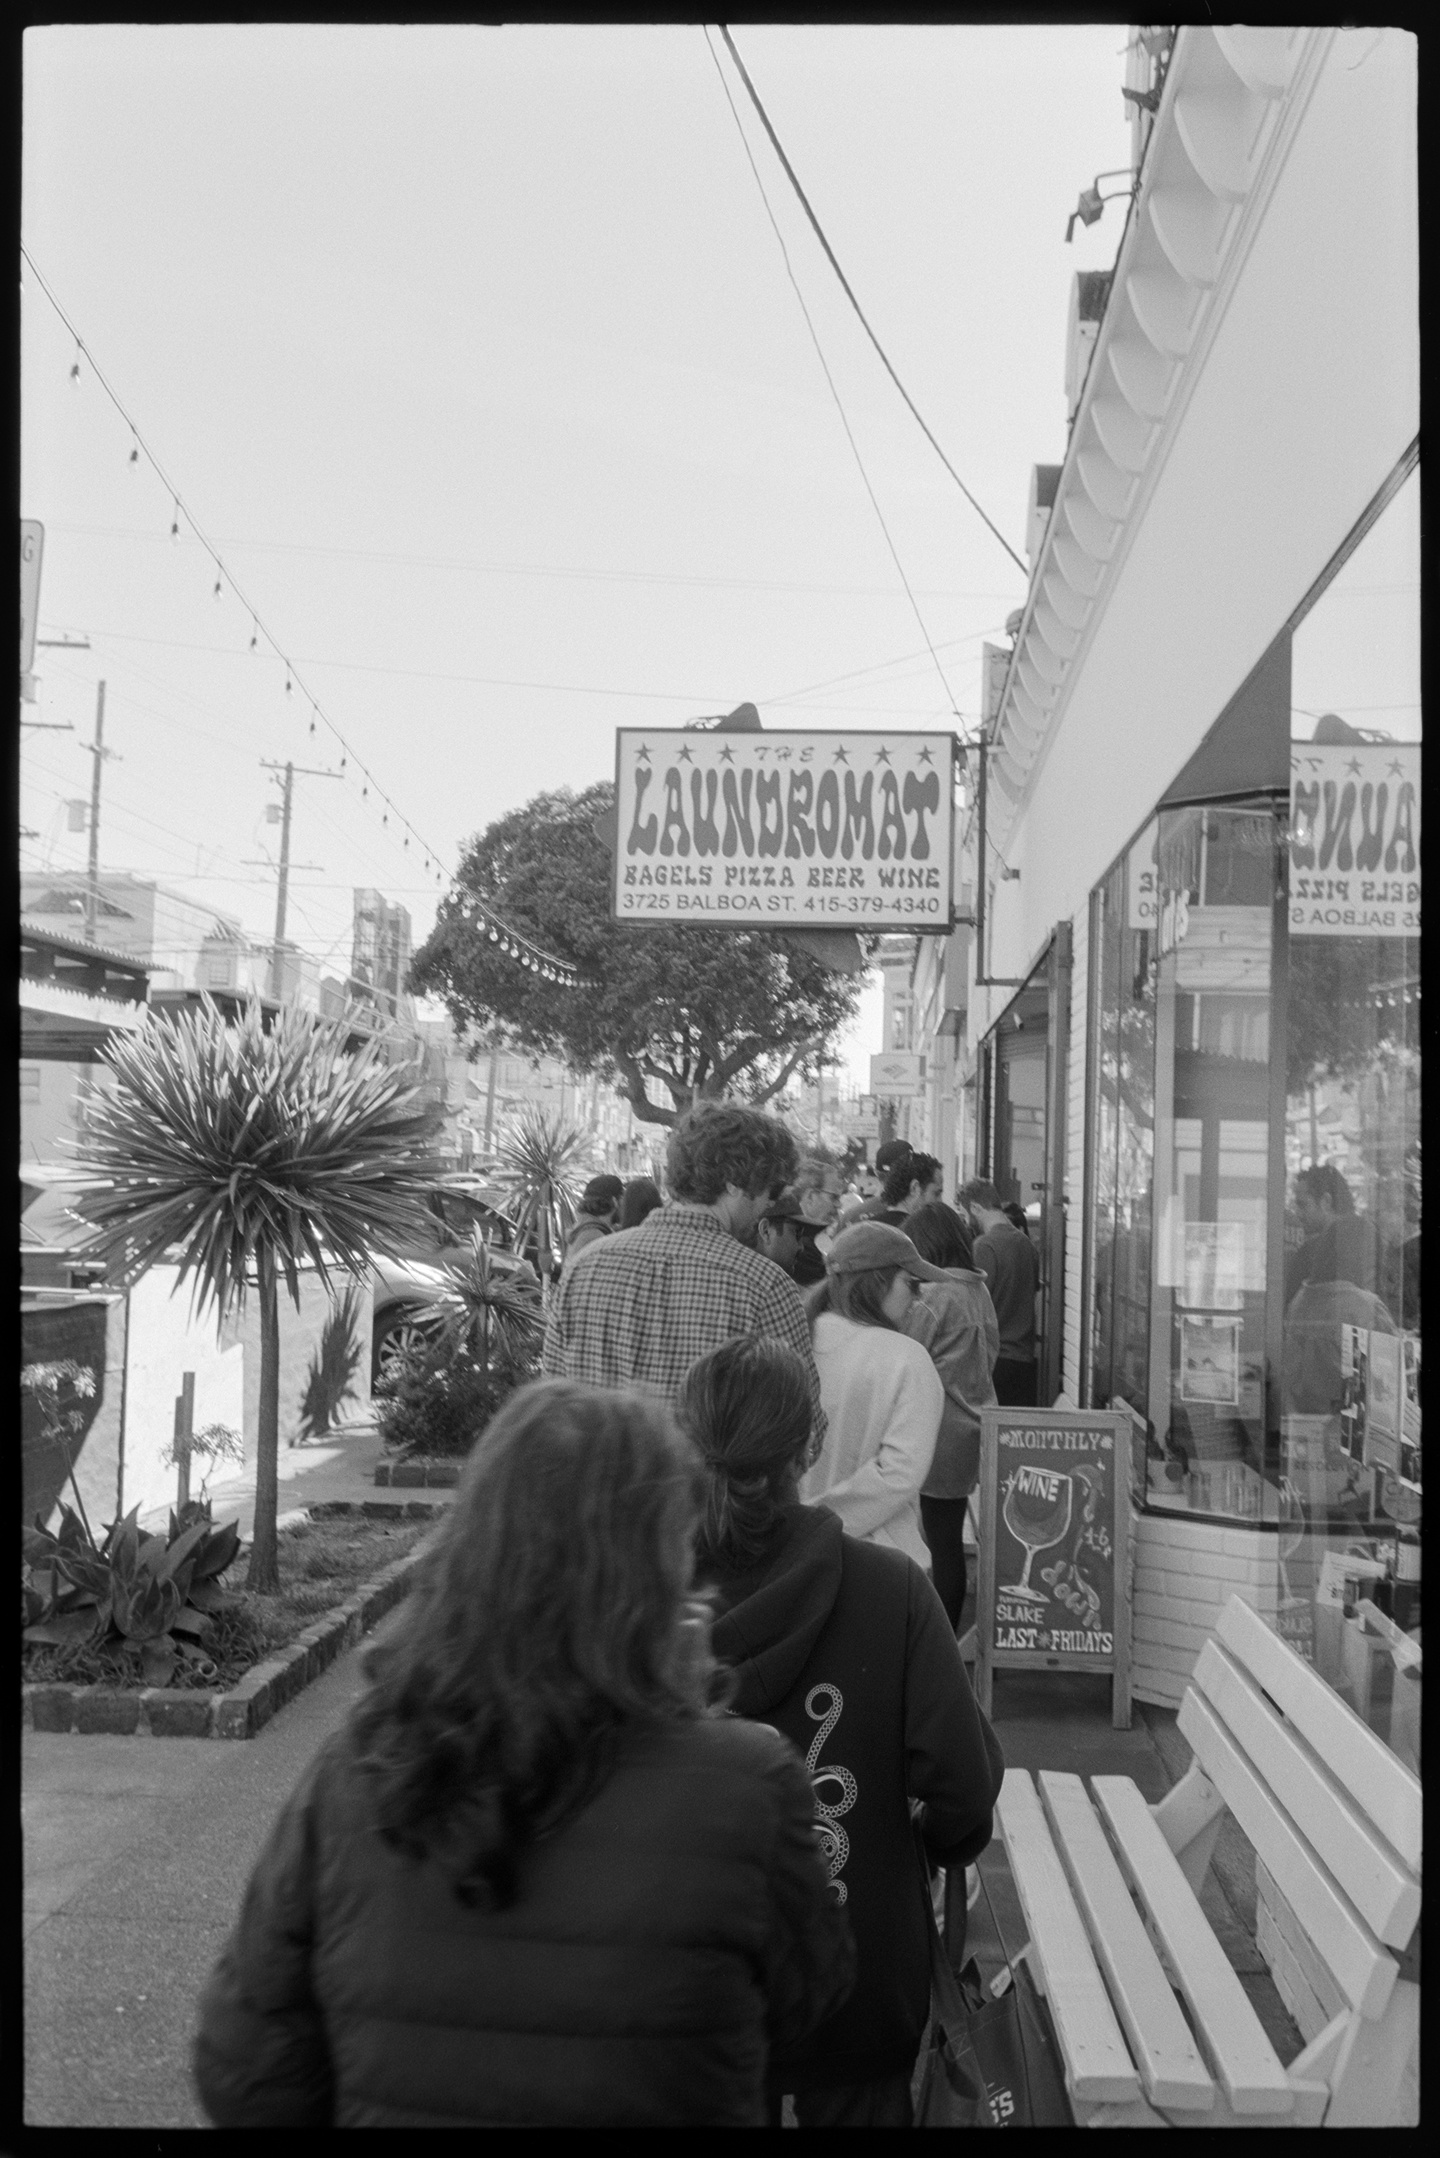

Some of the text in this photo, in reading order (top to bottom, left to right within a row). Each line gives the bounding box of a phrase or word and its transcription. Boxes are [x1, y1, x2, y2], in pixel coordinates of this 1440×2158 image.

[626, 766, 941, 861] LAUNDROMAT
[623, 864, 941, 889] BAGELS PIZZA BEER WINE
[622, 893, 940, 914] 3725 BALBOA ST. 415-379-4340
[1009, 1429, 1101, 1451] MONTHLY
[1018, 1471, 1060, 1502] WINE
[996, 1603, 1046, 1625] SLAKE
[996, 1627, 1113, 1654] LAST FRIDAYS
